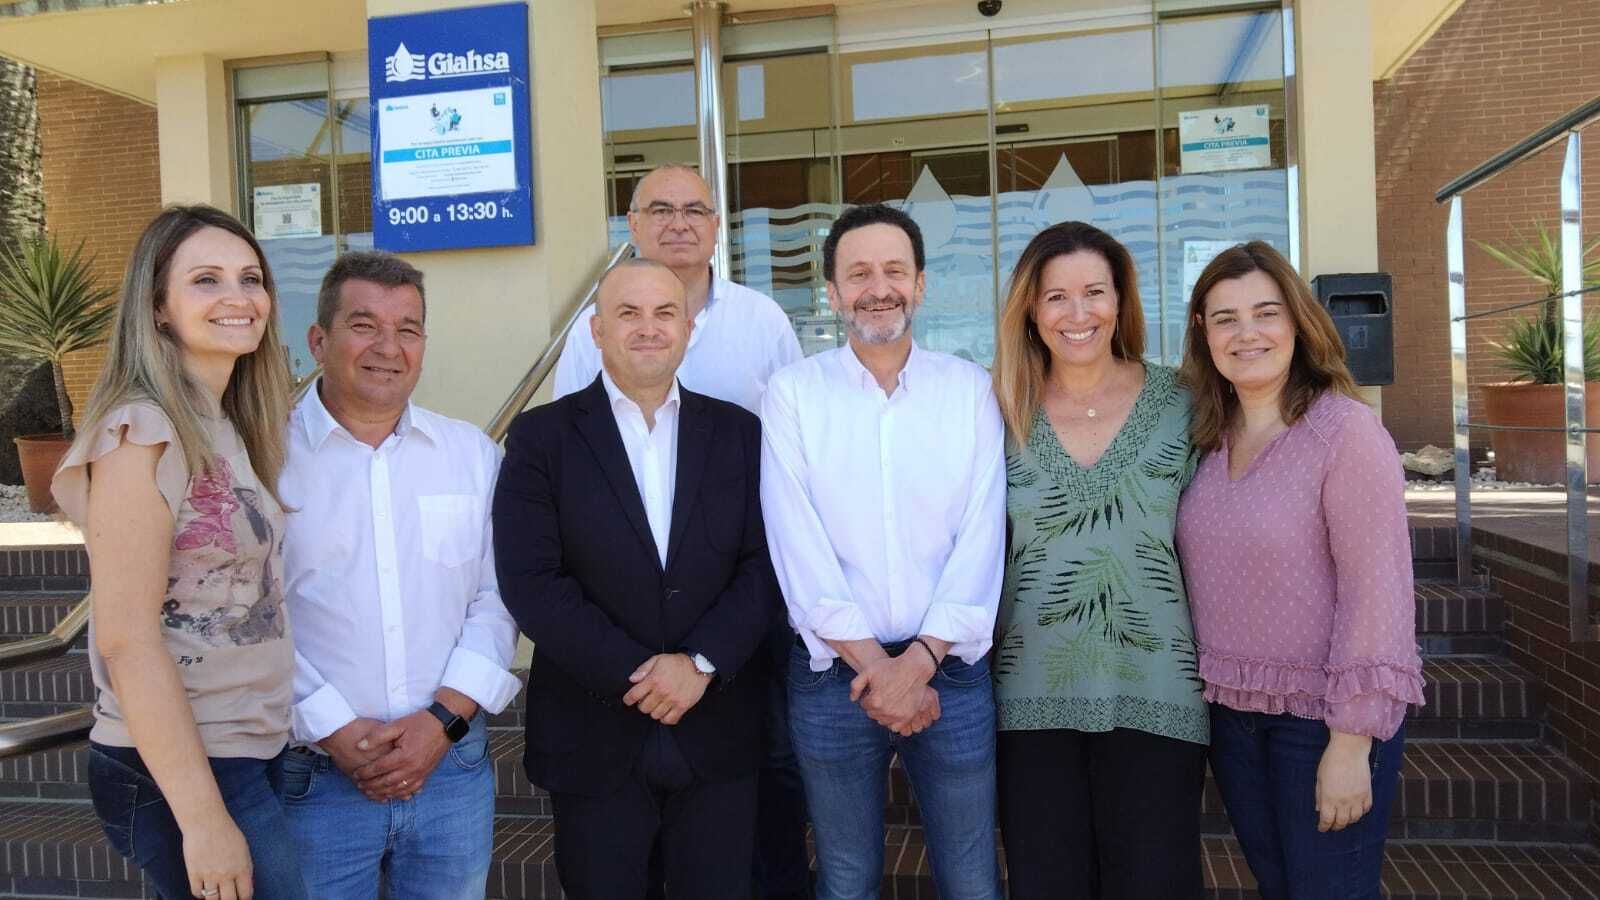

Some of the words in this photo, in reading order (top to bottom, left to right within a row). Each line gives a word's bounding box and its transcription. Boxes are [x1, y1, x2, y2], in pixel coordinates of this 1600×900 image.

[429, 49, 510, 76] Giahsa
[415, 148, 439, 160] CITA
[441, 144, 481, 157] PREVIA
[388, 206, 429, 225] 9:00
[433, 213, 441, 223] a
[446, 201, 498, 221] 13:30
[502, 206, 514, 219] h.
